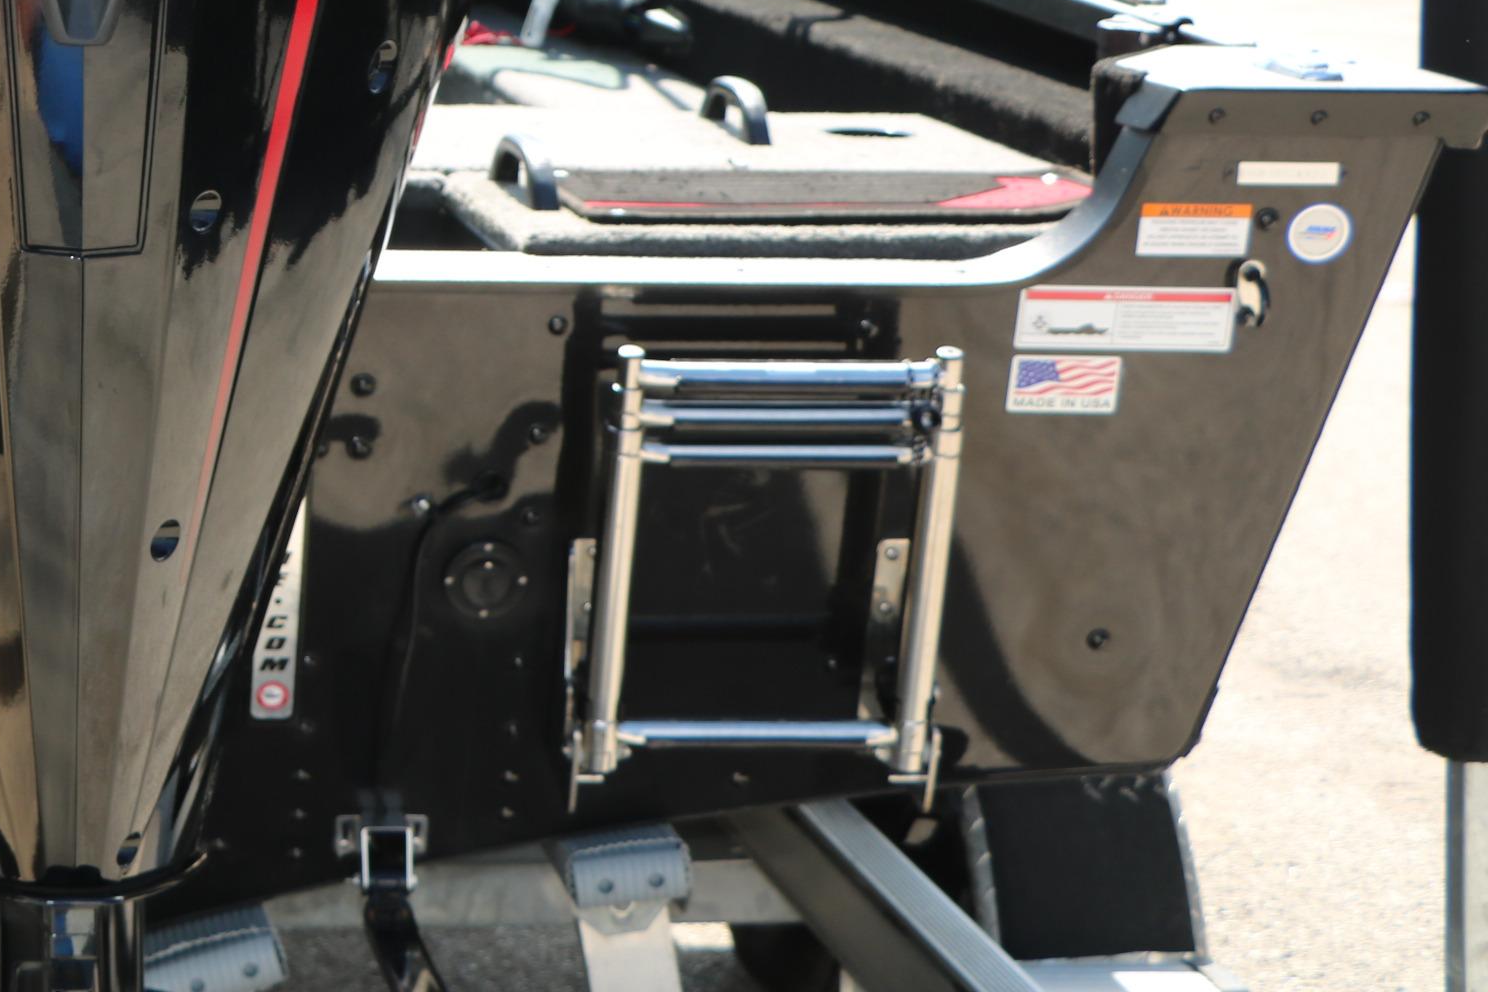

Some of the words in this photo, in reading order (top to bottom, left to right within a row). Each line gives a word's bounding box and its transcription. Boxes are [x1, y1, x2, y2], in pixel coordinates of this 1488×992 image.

[1172, 206, 1234, 217] WARNING
[1013, 397, 1056, 408] MADE
[1061, 397, 1076, 408] IN
[1082, 398, 1111, 409] USA
